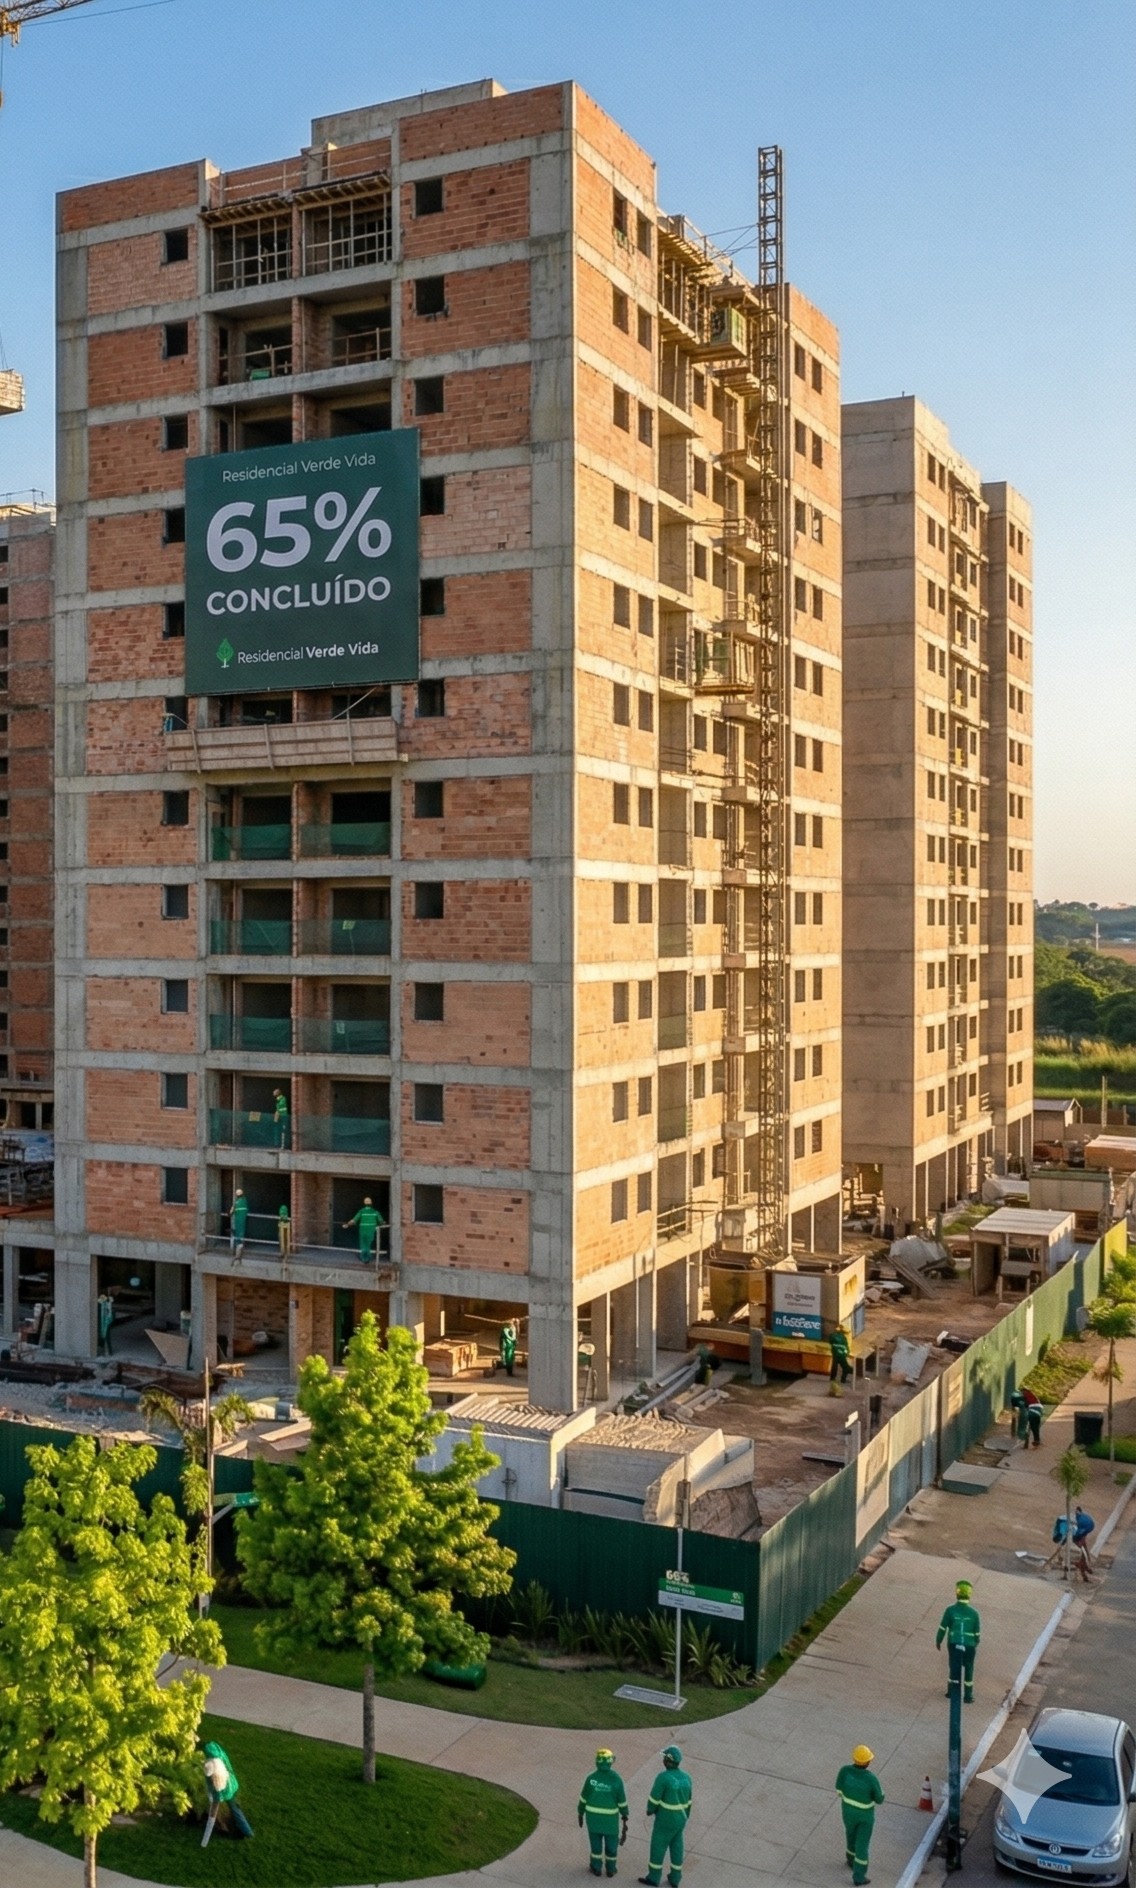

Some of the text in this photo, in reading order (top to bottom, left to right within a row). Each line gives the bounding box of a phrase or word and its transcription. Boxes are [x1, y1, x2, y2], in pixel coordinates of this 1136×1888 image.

[222, 453, 376, 482] Residencial Verde Vida
[206, 487, 392, 572] 65%
[206, 574, 391, 615] CONCLUÍDO
[237, 641, 379, 664] Residencial Verde Vida
